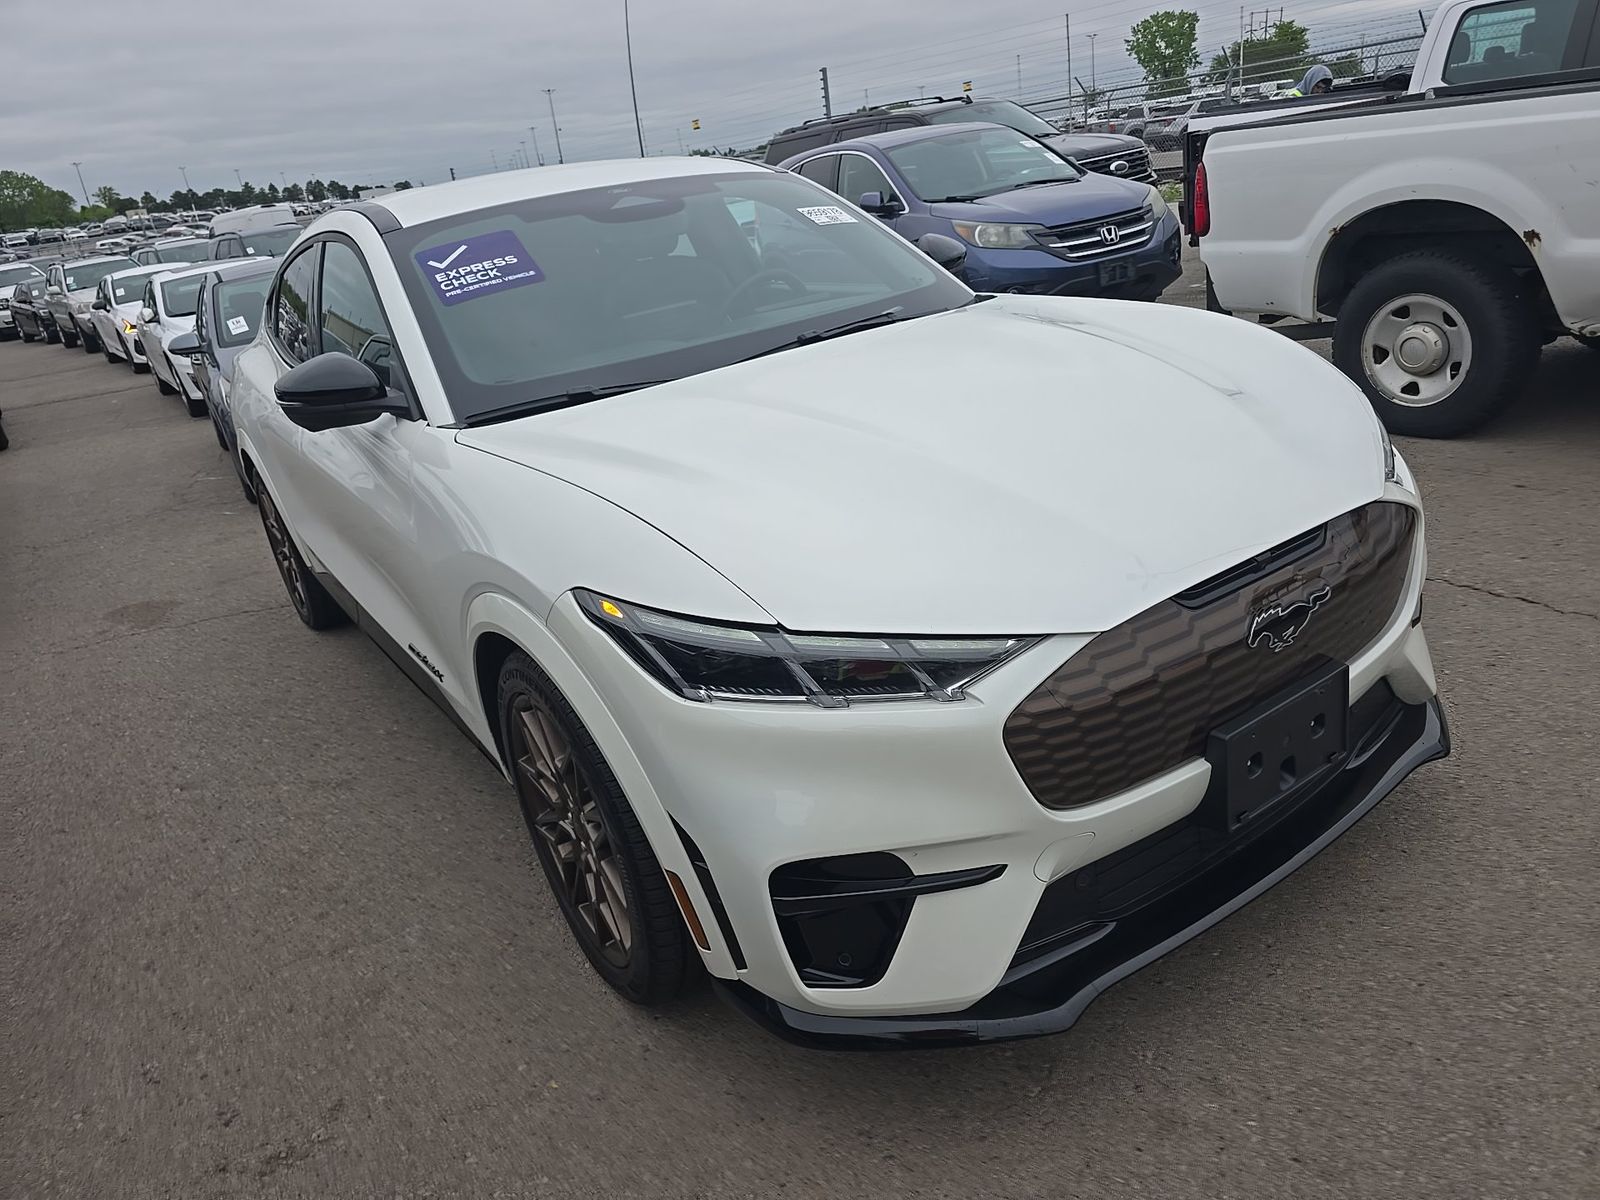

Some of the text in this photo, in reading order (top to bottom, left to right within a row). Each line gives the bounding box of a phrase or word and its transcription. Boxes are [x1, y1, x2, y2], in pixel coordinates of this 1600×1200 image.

[434, 255, 518, 283] EXPRESS
[440, 268, 502, 291] CHECK
[445, 270, 536, 298] PRE-CERTIFIED VEHICLE
